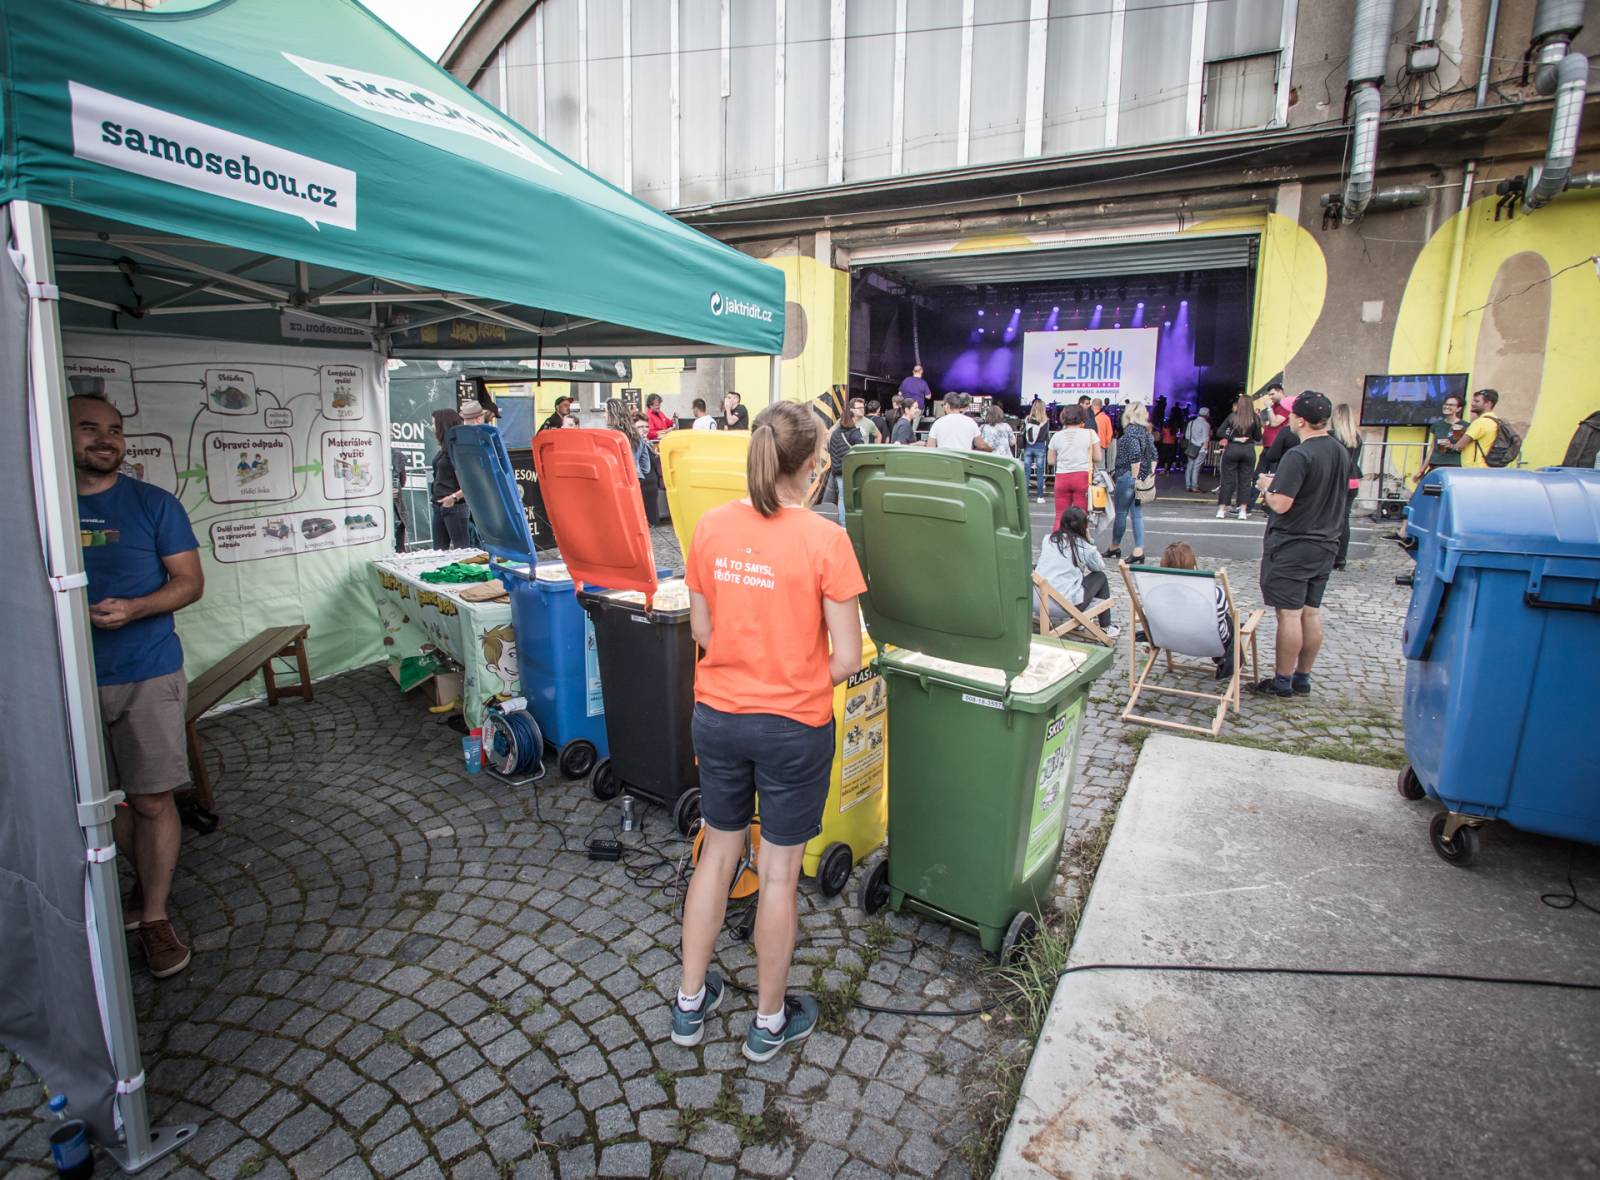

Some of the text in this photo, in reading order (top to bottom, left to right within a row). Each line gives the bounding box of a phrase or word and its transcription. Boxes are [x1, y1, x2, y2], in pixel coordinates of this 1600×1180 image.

[101, 120, 338, 208] samosebou.cz
[725, 296, 773, 322] jaktridit.cz
[252, 439, 284, 450] odpadu
[328, 437, 373, 449] Materiálové
[126, 444, 162, 457] ejnery
[514, 469, 538, 483] ESON
[714, 557, 728, 568] MÁ
[730, 560, 743, 570] TO
[848, 668, 877, 688] PLAST
[1047, 716, 1067, 739] SKLO
